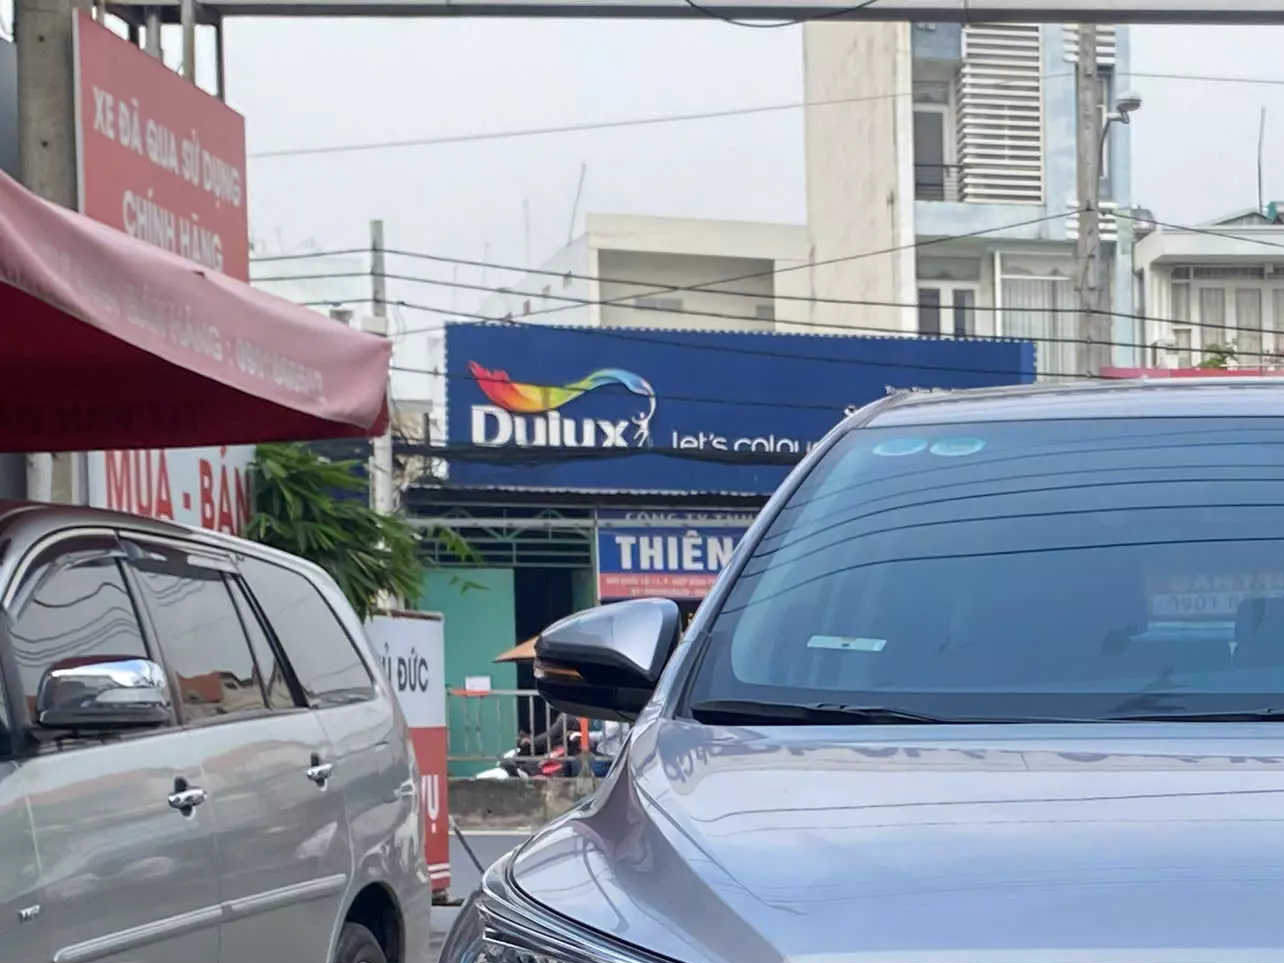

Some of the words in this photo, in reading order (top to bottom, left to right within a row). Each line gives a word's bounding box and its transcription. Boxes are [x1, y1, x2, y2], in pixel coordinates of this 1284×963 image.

[93, 85, 115, 139] XE
[145, 119, 180, 175] QUA
[472, 404, 629, 448] Dulux
[104, 450, 174, 521] MUA
[198, 446, 251, 537] BÁN
[615, 530, 734, 570] THIÊN
[398, 648, 429, 693] ĐỨC
